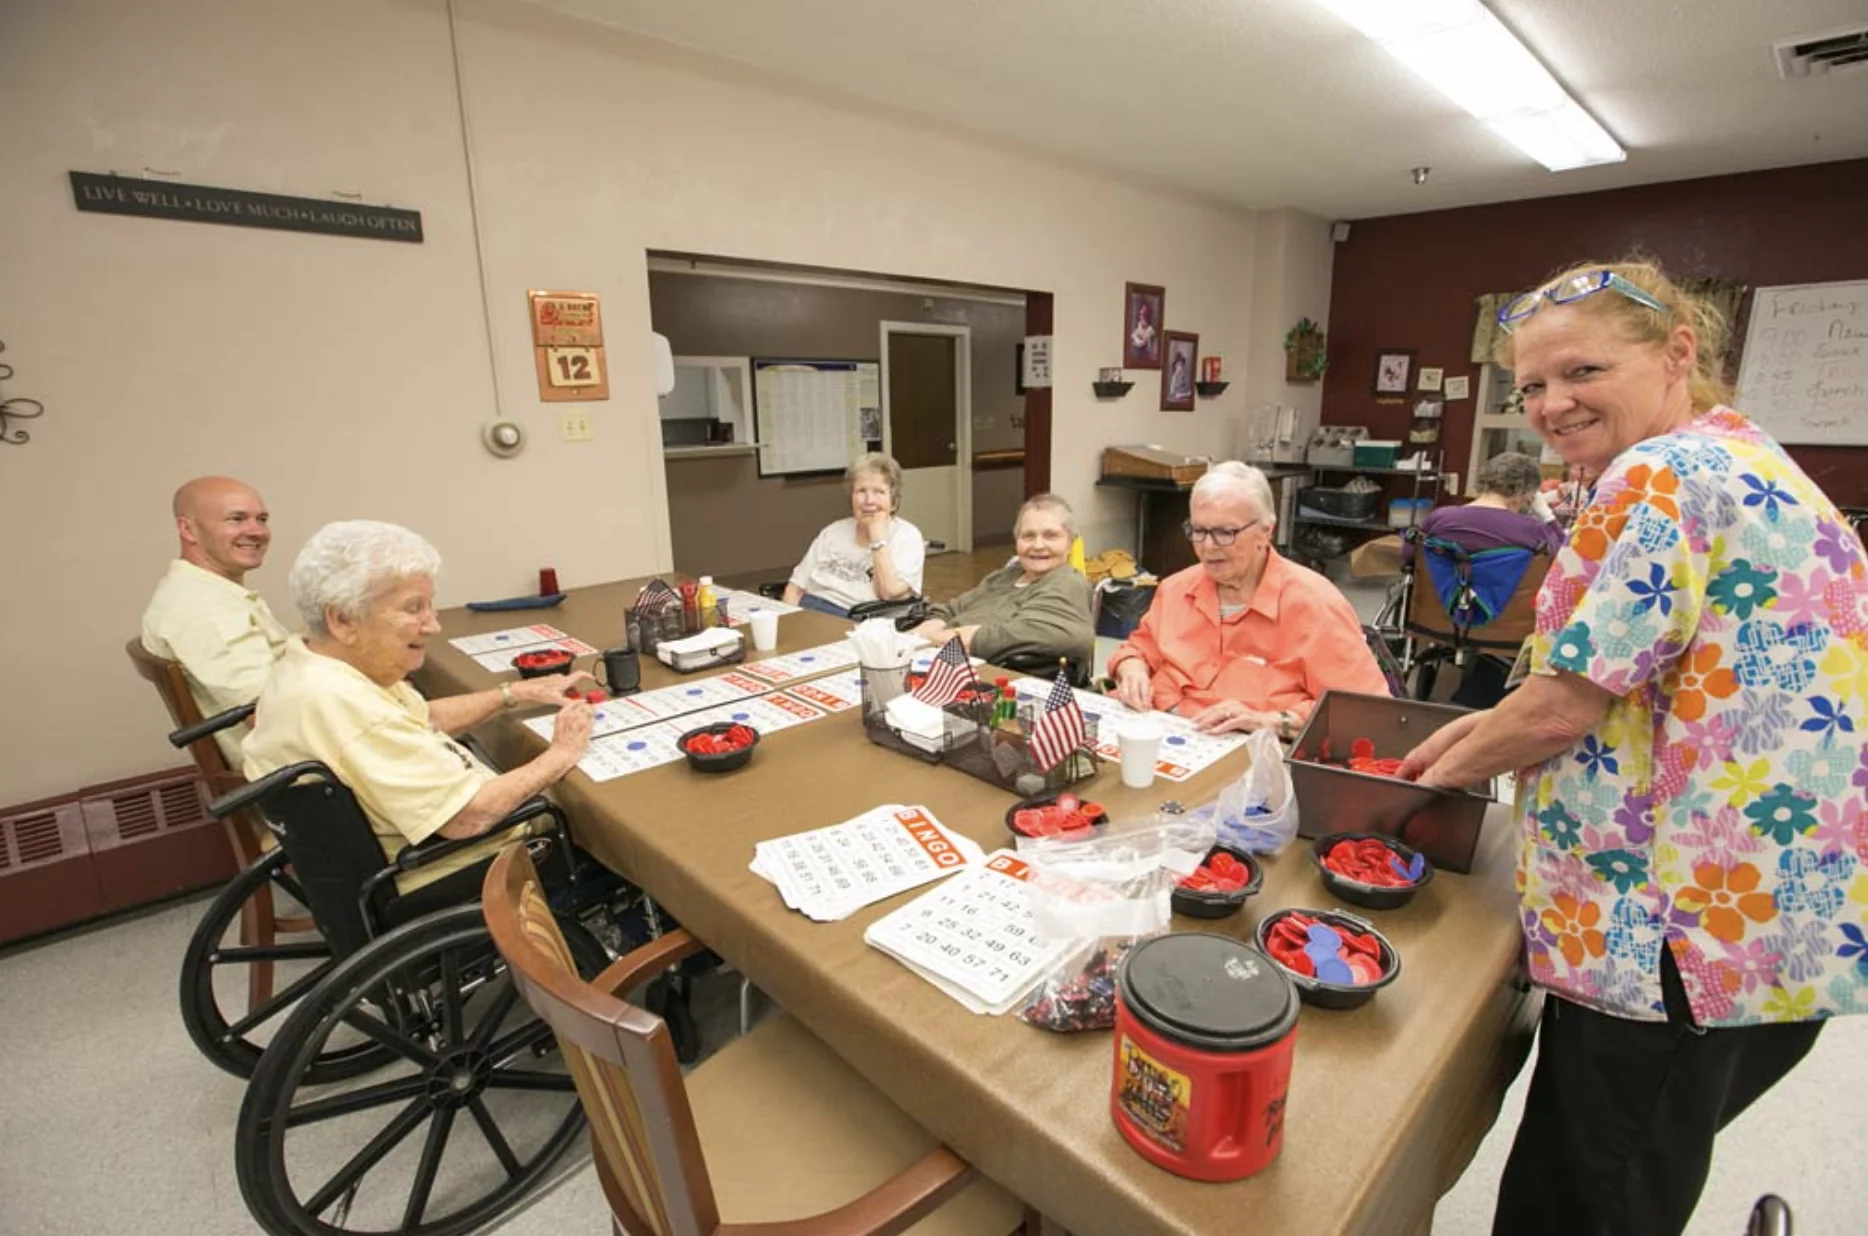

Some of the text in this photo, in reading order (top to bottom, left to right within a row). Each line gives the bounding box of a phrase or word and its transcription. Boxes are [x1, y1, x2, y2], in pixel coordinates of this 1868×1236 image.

[82, 184, 417, 232] LIVE WELL LOVE MUCH LAUGH OFTEN
[556, 355, 592, 380] 12
[898, 808, 961, 867] BINGO
[937, 917, 957, 930] 25
[960, 927, 981, 940] 32
[985, 937, 1006, 952] 49
[1009, 951, 1031, 967] 63
[1003, 923, 1025, 937] 59
[916, 932, 937, 945] 20
[940, 943, 961, 957] 40
[963, 954, 986, 968] 57
[989, 967, 1009, 982] 71
